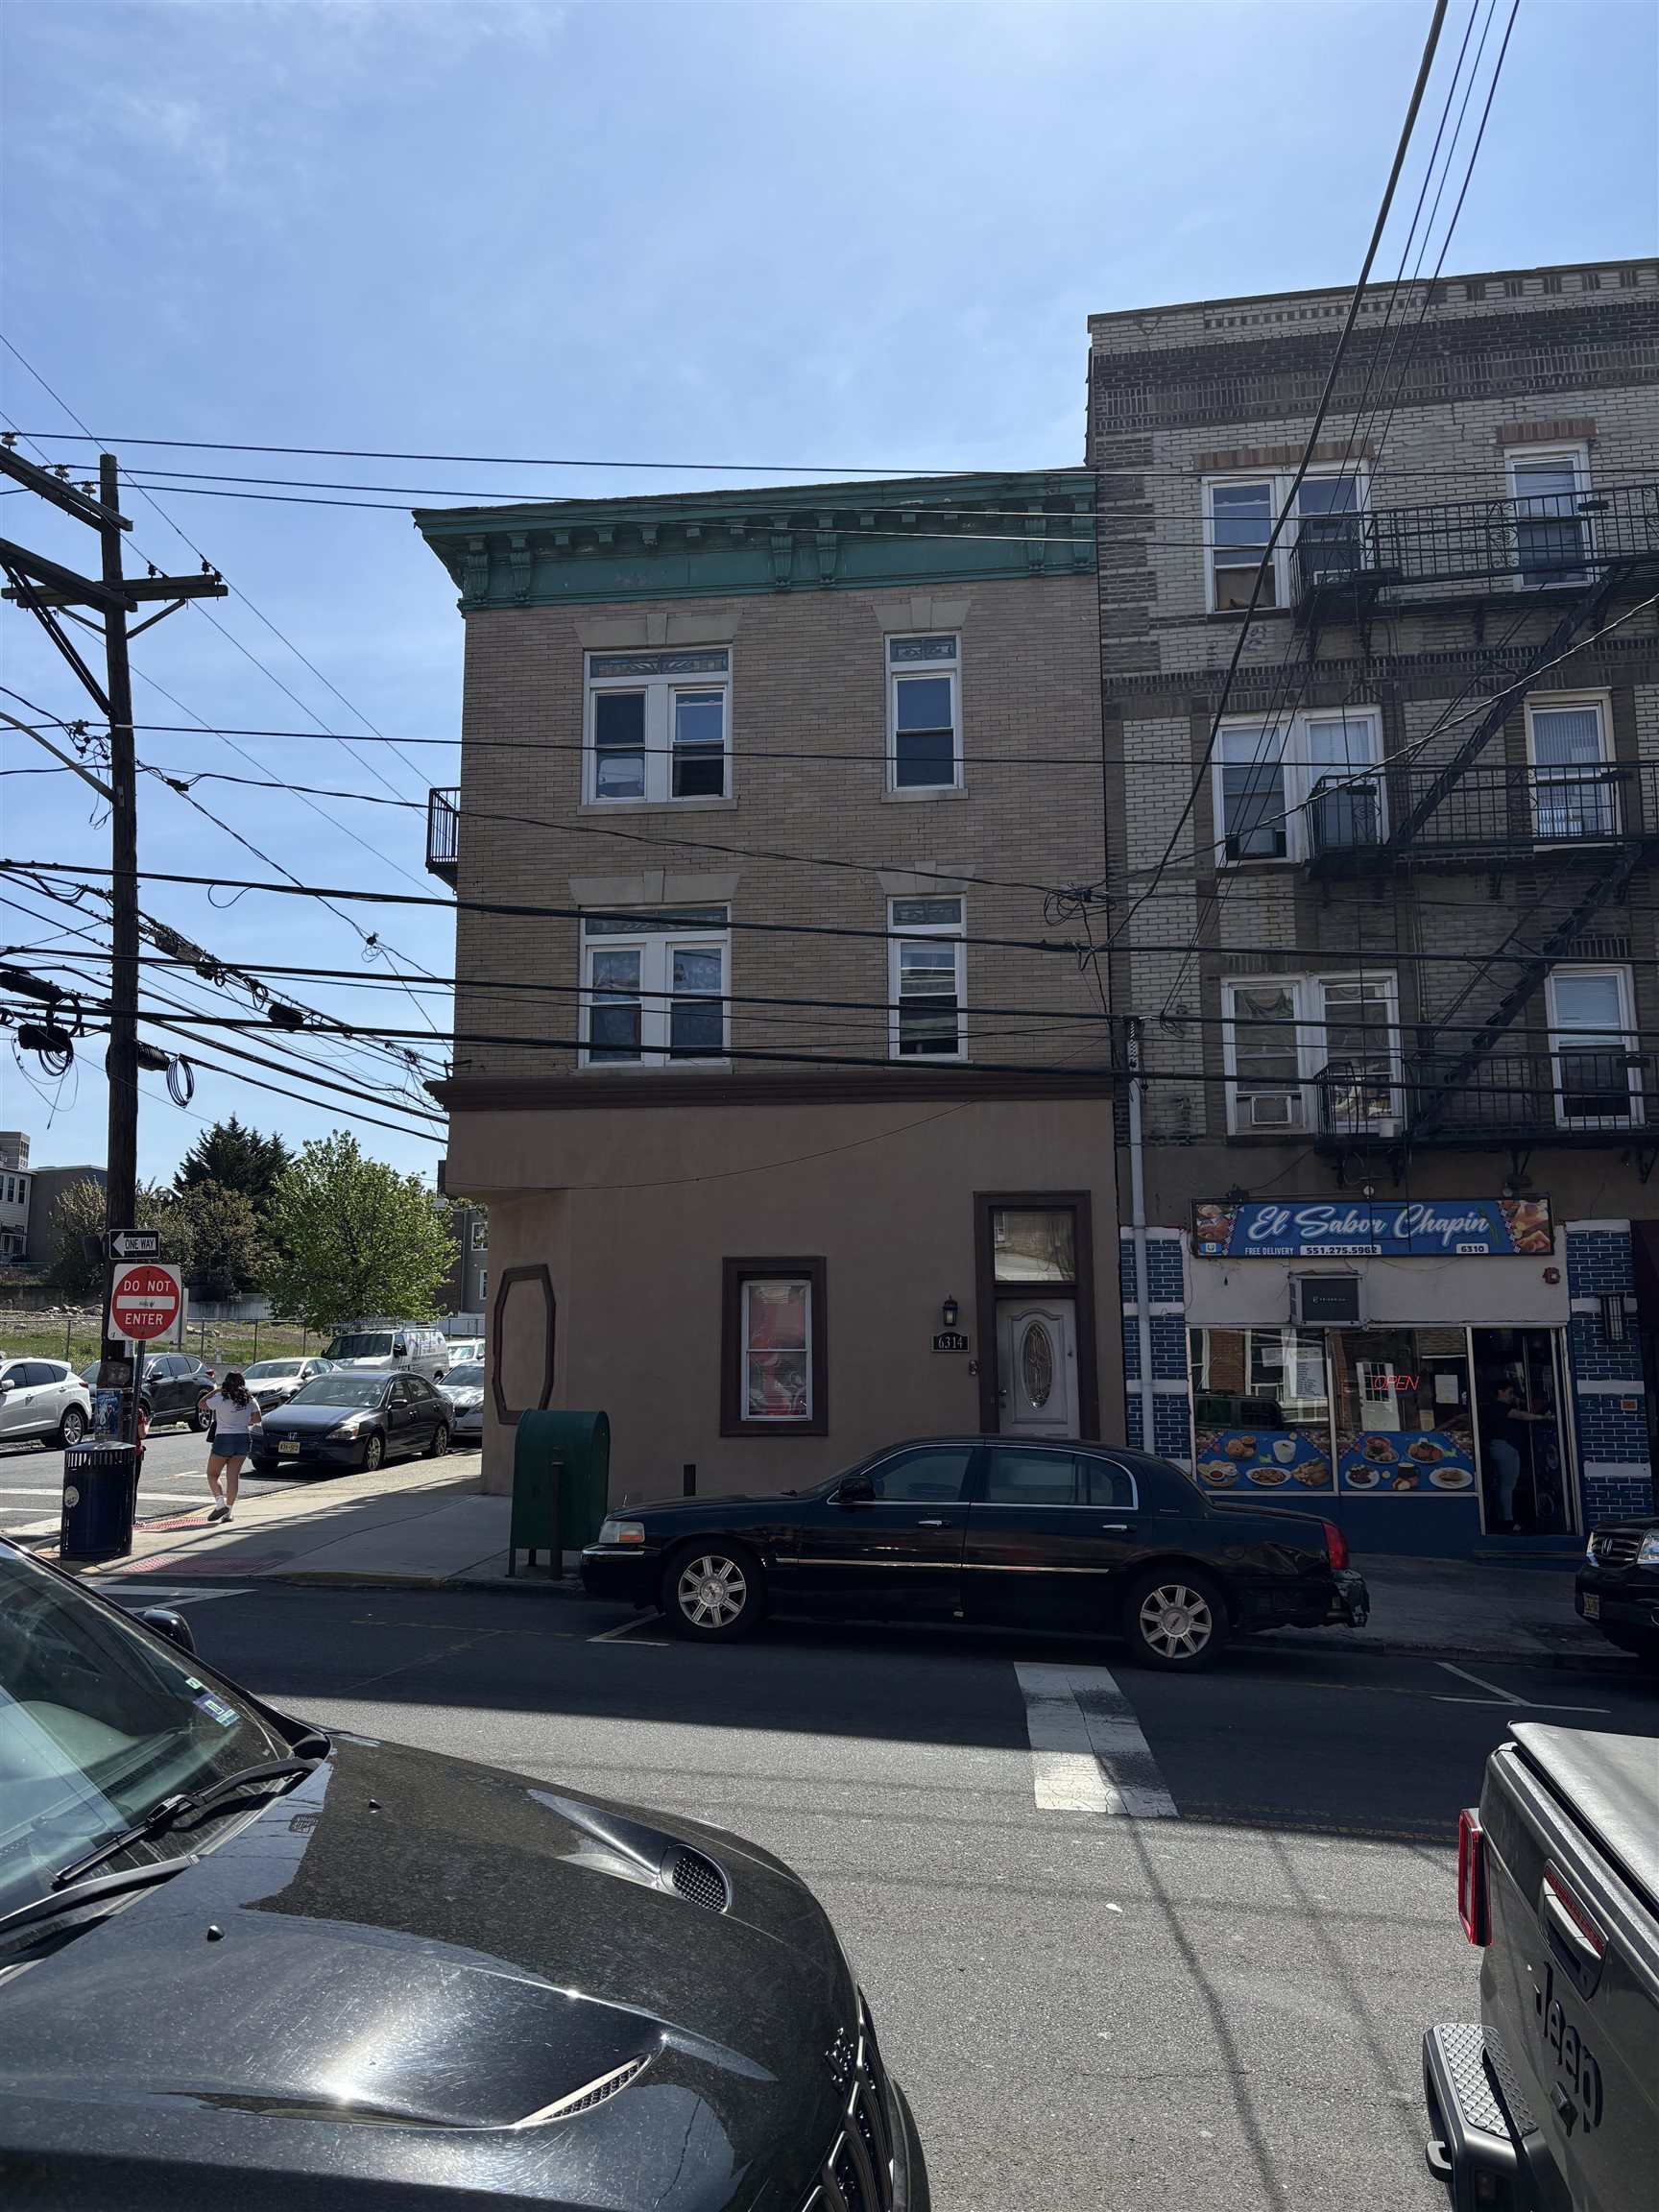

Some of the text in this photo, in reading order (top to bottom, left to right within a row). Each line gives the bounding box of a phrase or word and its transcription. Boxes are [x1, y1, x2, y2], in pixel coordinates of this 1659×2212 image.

[1247, 1204, 1490, 1247] El Sabor Chapin
[125, 1238, 155, 1250] ONE WAY
[1306, 1246, 1378, 1255] 551.275.5962
[1244, 1246, 1294, 1256] FREE DELIVERY
[123, 1280, 171, 1292] DO NOT
[125, 1312, 163, 1325] ENTER
[938, 1336, 963, 1349] 6314
[1374, 1375, 1420, 1391] OPEN
[1533, 1960, 1603, 2133] Jeep
